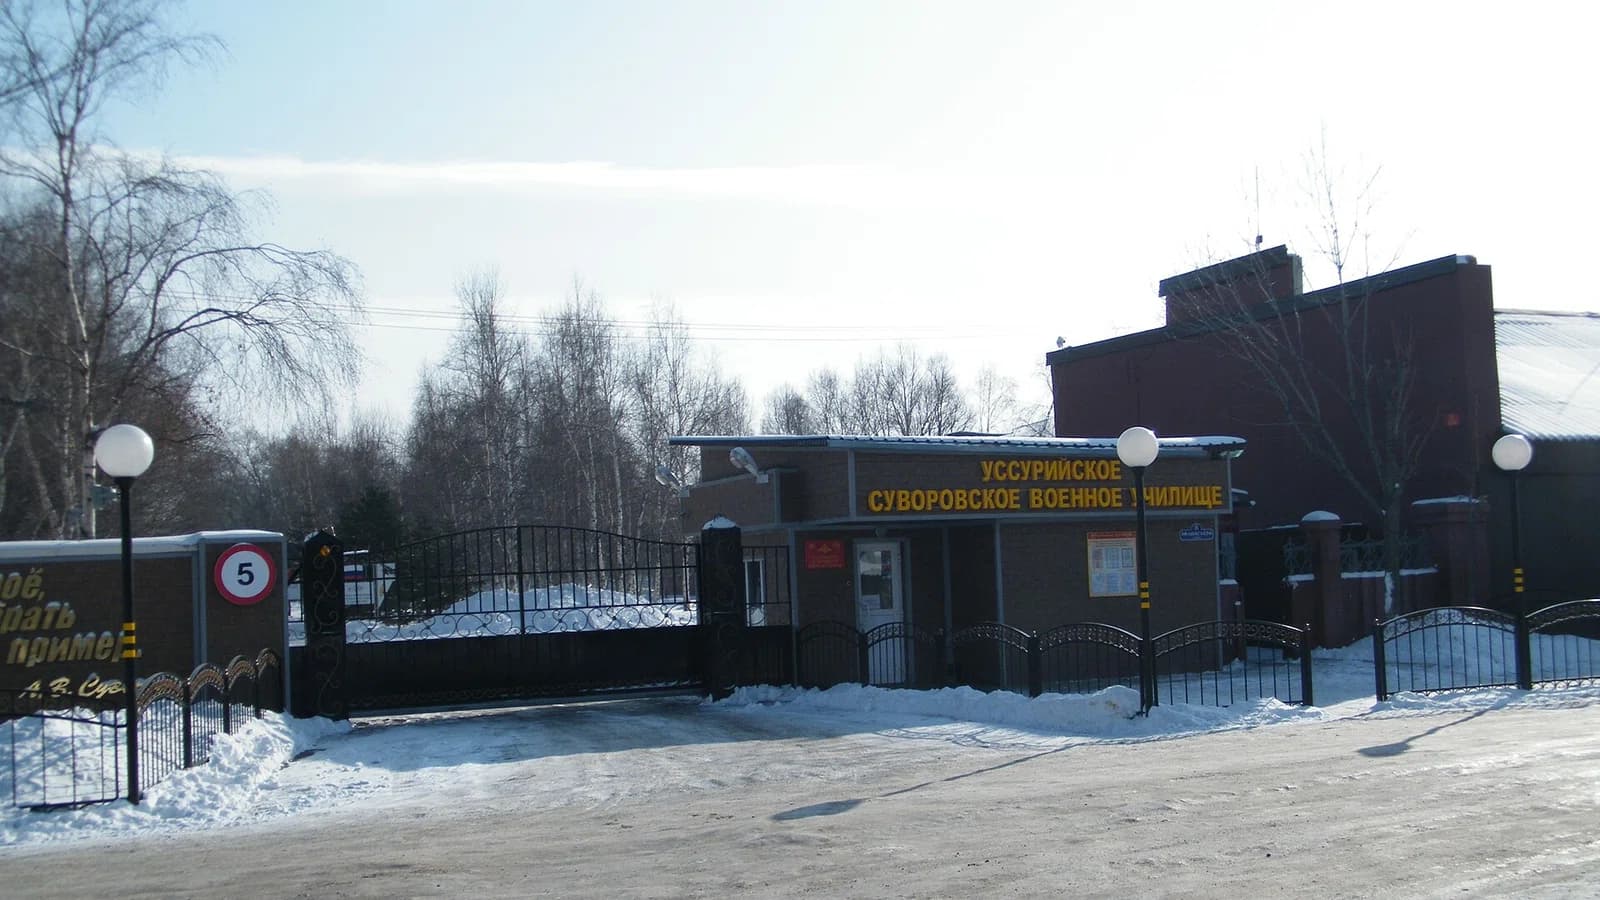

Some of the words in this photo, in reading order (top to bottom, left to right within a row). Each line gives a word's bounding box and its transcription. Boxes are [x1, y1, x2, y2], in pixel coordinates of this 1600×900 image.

[981, 458, 1121, 482] УССУРИЙСКОЕ
[867, 487, 1021, 512] СУВОРОВСКОЕ
[1029, 486, 1122, 510] ВОЕННОЕ
[0, 567, 45, 601] оё,
[236, 561, 255, 586] 5
